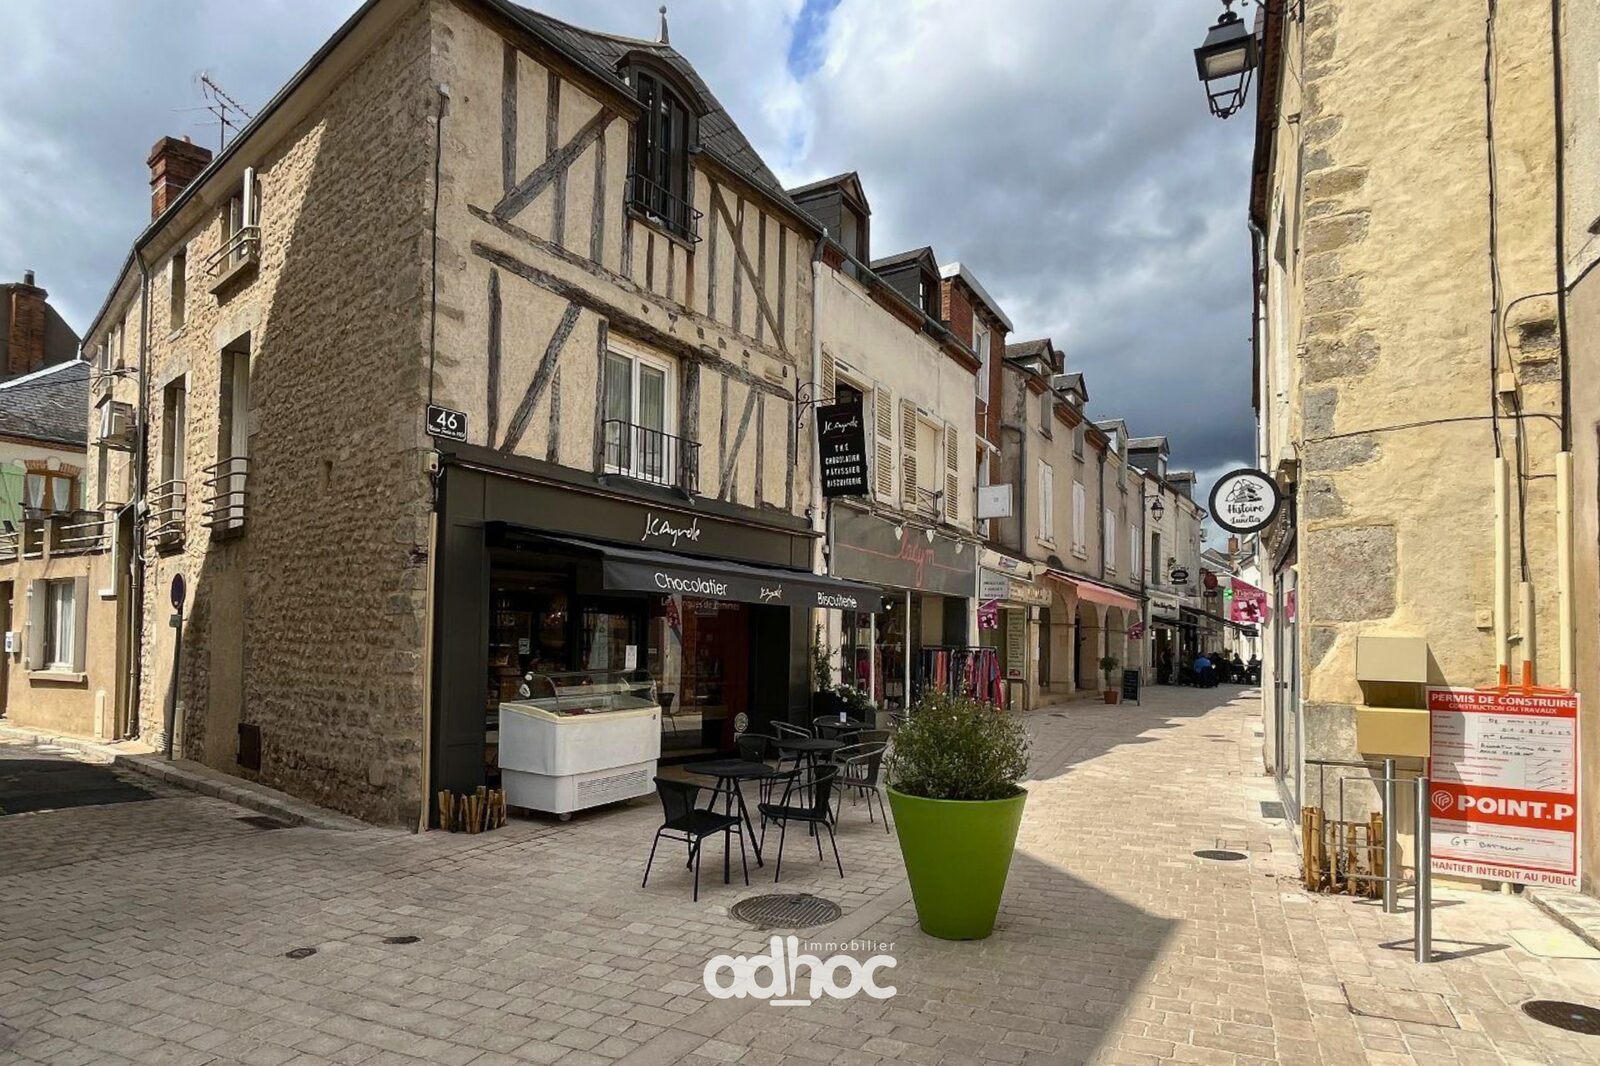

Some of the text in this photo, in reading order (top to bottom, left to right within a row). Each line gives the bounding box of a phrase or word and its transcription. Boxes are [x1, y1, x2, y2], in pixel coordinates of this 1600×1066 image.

[436, 411, 458, 430] 46
[1227, 503, 1265, 514] Histoire
[654, 572, 728, 597] Chocolatier
[817, 591, 858, 609] Biscuiterie
[1431, 693, 1576, 707] PERMIS DE CONSTRUIRE
[1448, 703, 1505, 712] CONSTRUCTION
[1457, 794, 1574, 820] POINT.P
[1432, 861, 1577, 887] HANTIER INTERDIT AU PUBLIC
